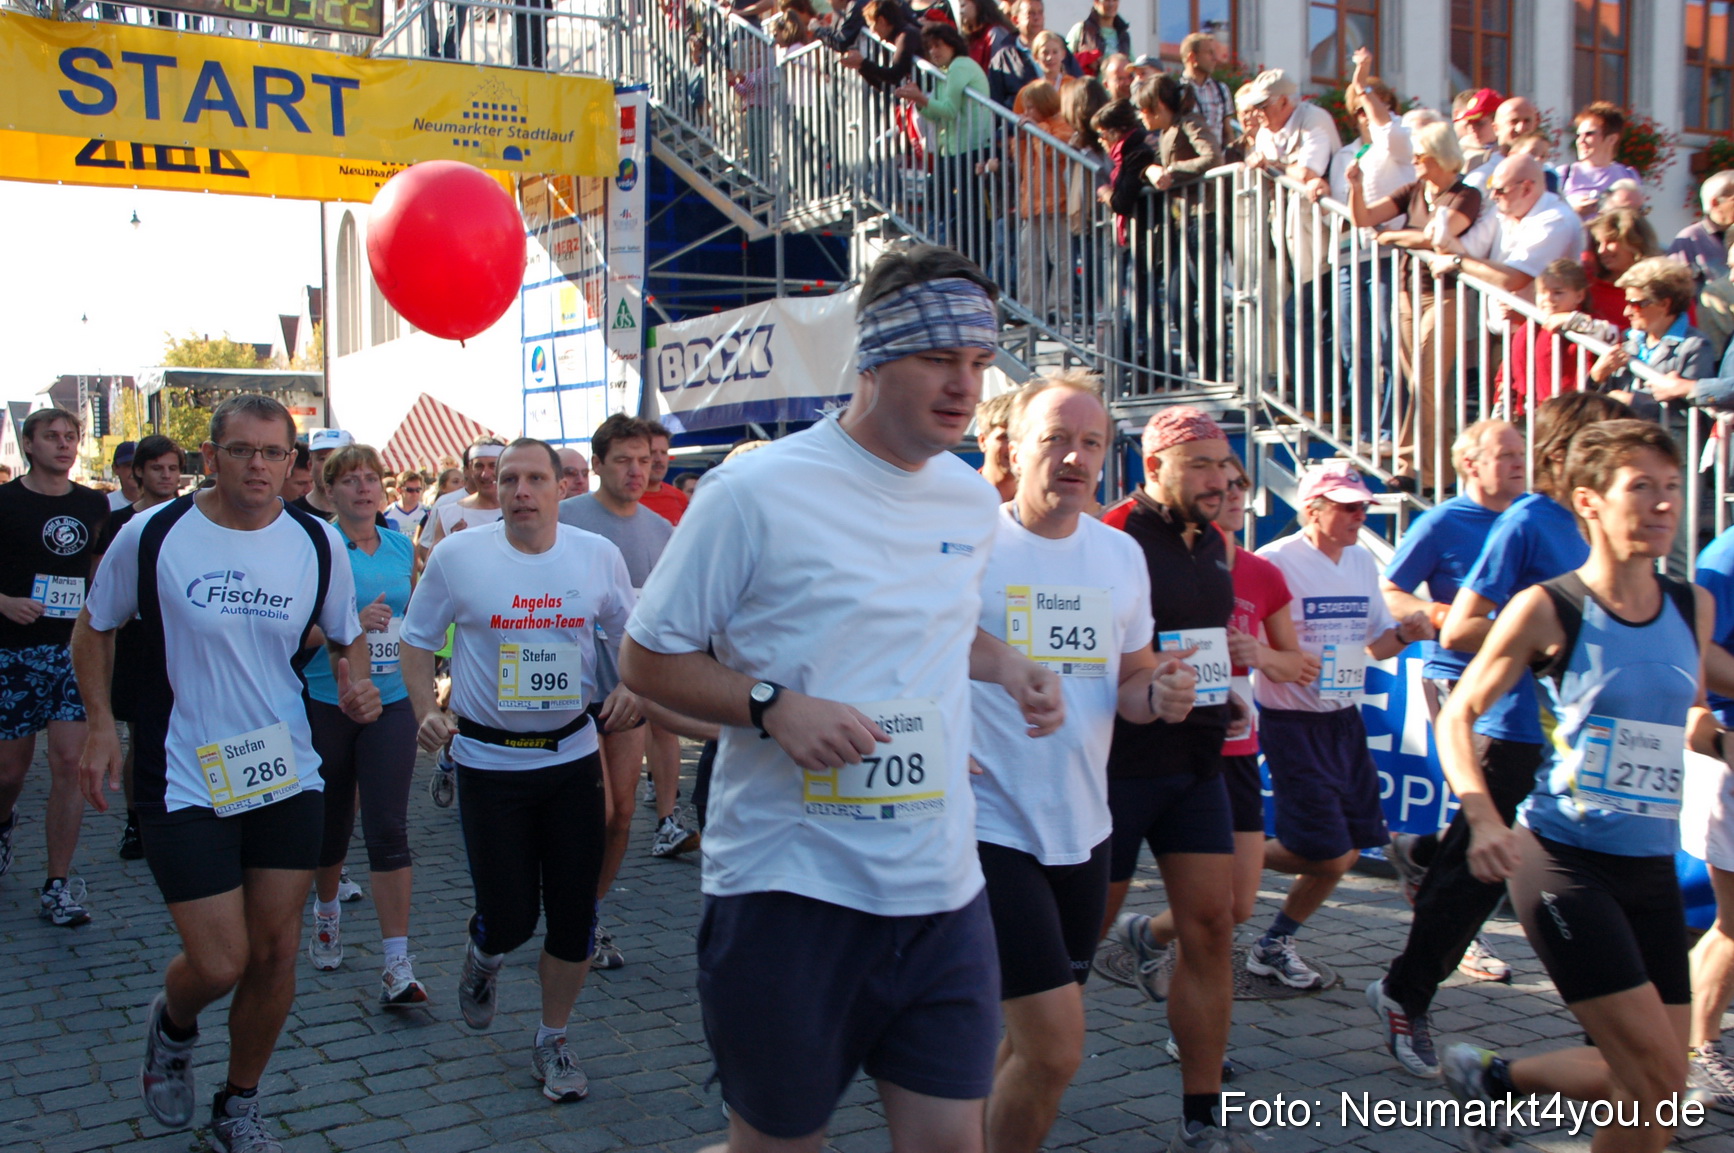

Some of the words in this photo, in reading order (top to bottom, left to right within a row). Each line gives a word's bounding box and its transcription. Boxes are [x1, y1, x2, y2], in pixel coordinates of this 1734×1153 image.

[58, 47, 360, 137] START
[413, 117, 503, 138] Neumarkter
[507, 125, 574, 143] Stadtlauf
[659, 323, 776, 392] BOCK
[50, 591, 81, 605] 3171
[207, 586, 293, 609] Fischer
[512, 593, 562, 613] Angelas
[1036, 592, 1082, 612] Roland
[220, 605, 290, 621] Automobile
[490, 614, 586, 630] Marathon-Team
[1013, 618, 1020, 632] D
[1049, 625, 1097, 651] 543
[523, 649, 557, 663] Stefan
[503, 668, 509, 679] D
[530, 672, 569, 692] 996
[875, 713, 925, 735] istian
[224, 739, 266, 760] Stefan
[209, 772, 218, 784] C
[242, 756, 288, 788] 286
[862, 752, 925, 789] 708
[1615, 761, 1683, 794] 2735
